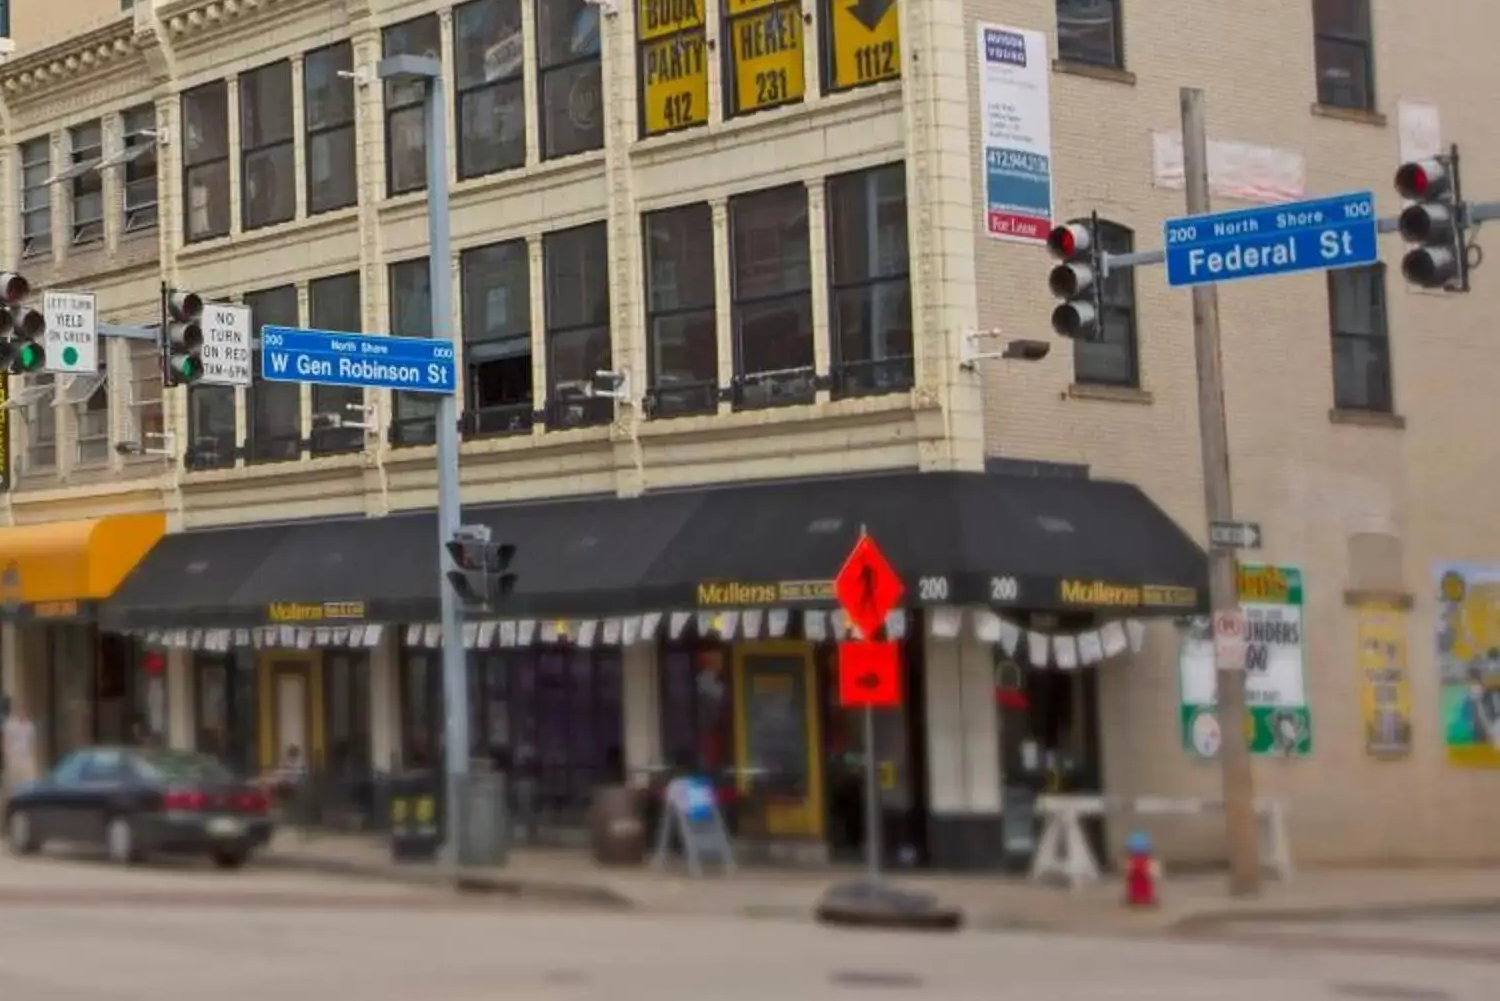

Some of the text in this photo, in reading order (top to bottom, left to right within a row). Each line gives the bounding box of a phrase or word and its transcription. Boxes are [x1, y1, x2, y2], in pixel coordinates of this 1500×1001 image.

[647, 11, 798, 86] PARTY HERE!
[664, 40, 895, 127] 412 231 1112
[1169, 201, 1370, 244] 200 North Shore 100
[1188, 230, 1354, 276] Federal St
[55, 312, 85, 328] YIELD
[216, 311, 235, 326] NO
[211, 328, 242, 343] TURN
[331, 338, 357, 352] North
[361, 341, 388, 354] Shore
[203, 344, 248, 361] ON RED
[271, 353, 448, 385] W Gen Robinson St
[918, 576, 948, 600] 200
[991, 576, 1018, 600] 200
